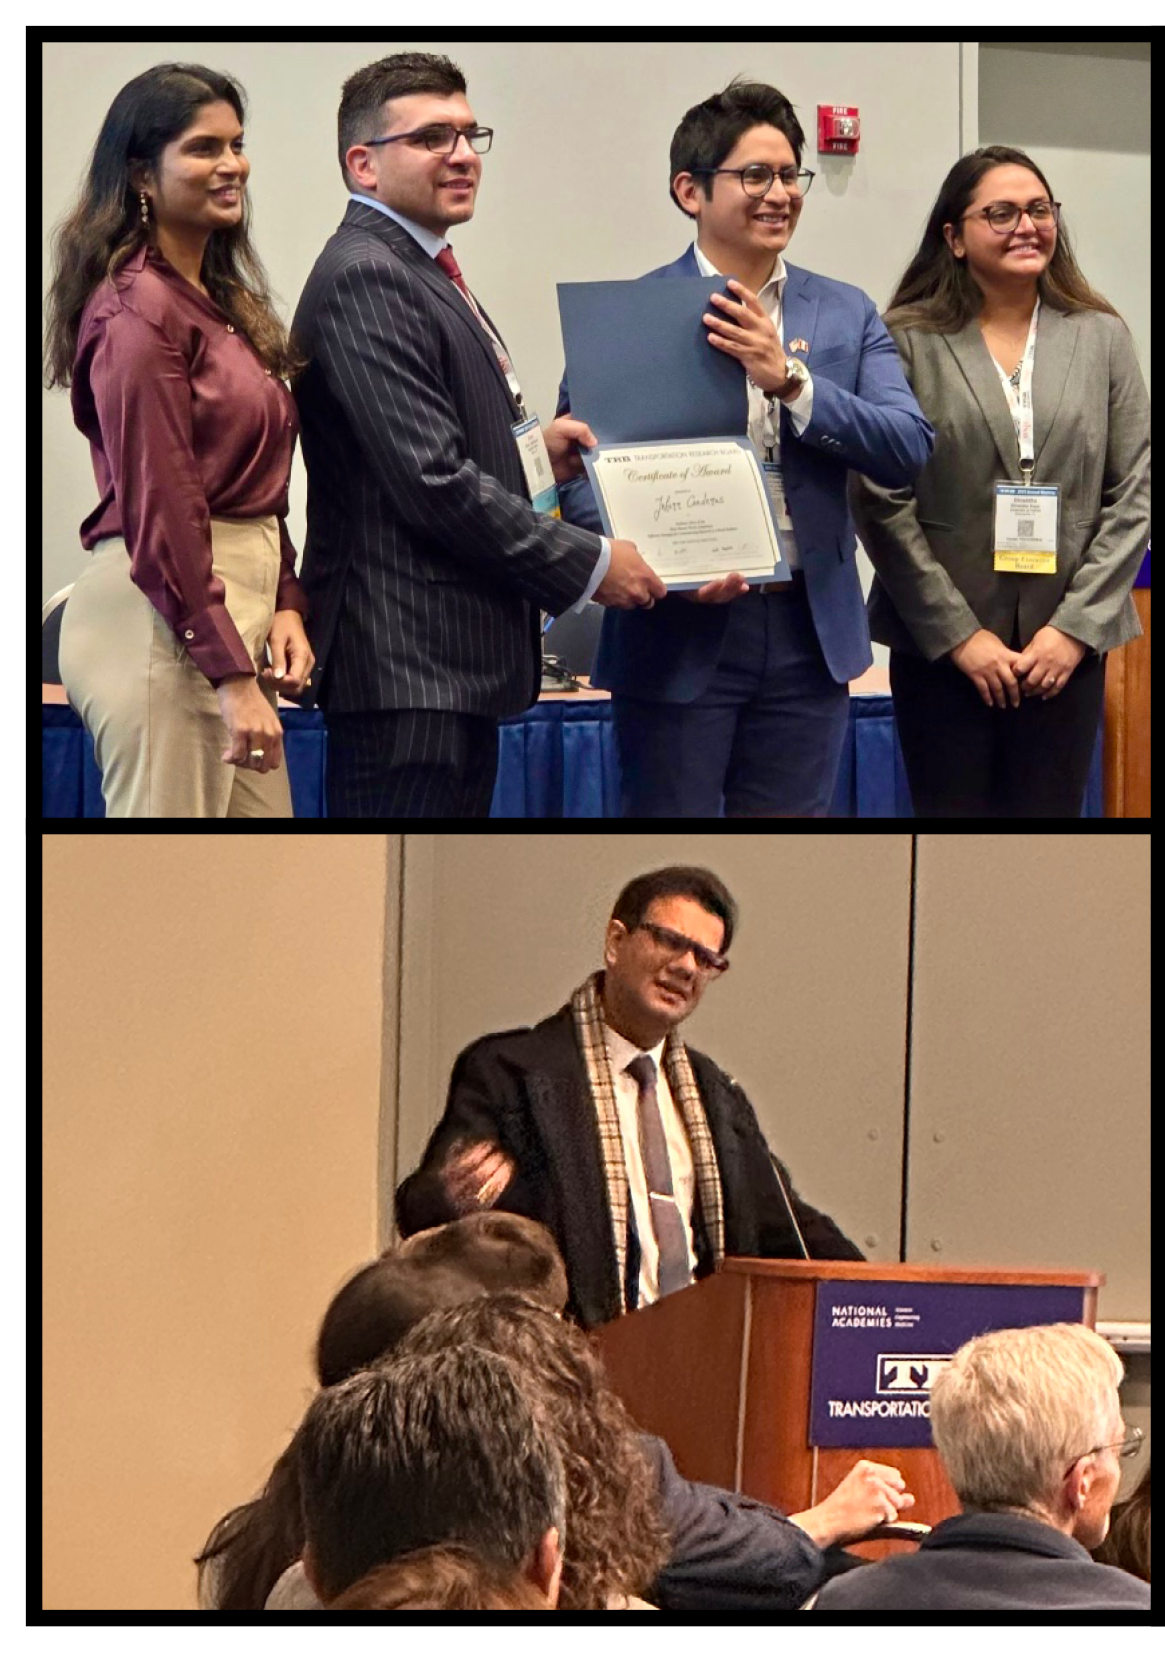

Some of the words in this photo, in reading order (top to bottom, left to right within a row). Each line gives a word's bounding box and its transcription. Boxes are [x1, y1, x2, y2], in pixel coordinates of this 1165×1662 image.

[832, 107, 848, 115] FIRE
[832, 143, 848, 151] FIRE
[623, 468, 677, 484] Certificate
[679, 467, 691, 480] of
[691, 464, 732, 477] Award
[831, 1306, 888, 1316] NATIONAL
[831, 1317, 893, 1328] ACADEMIES
